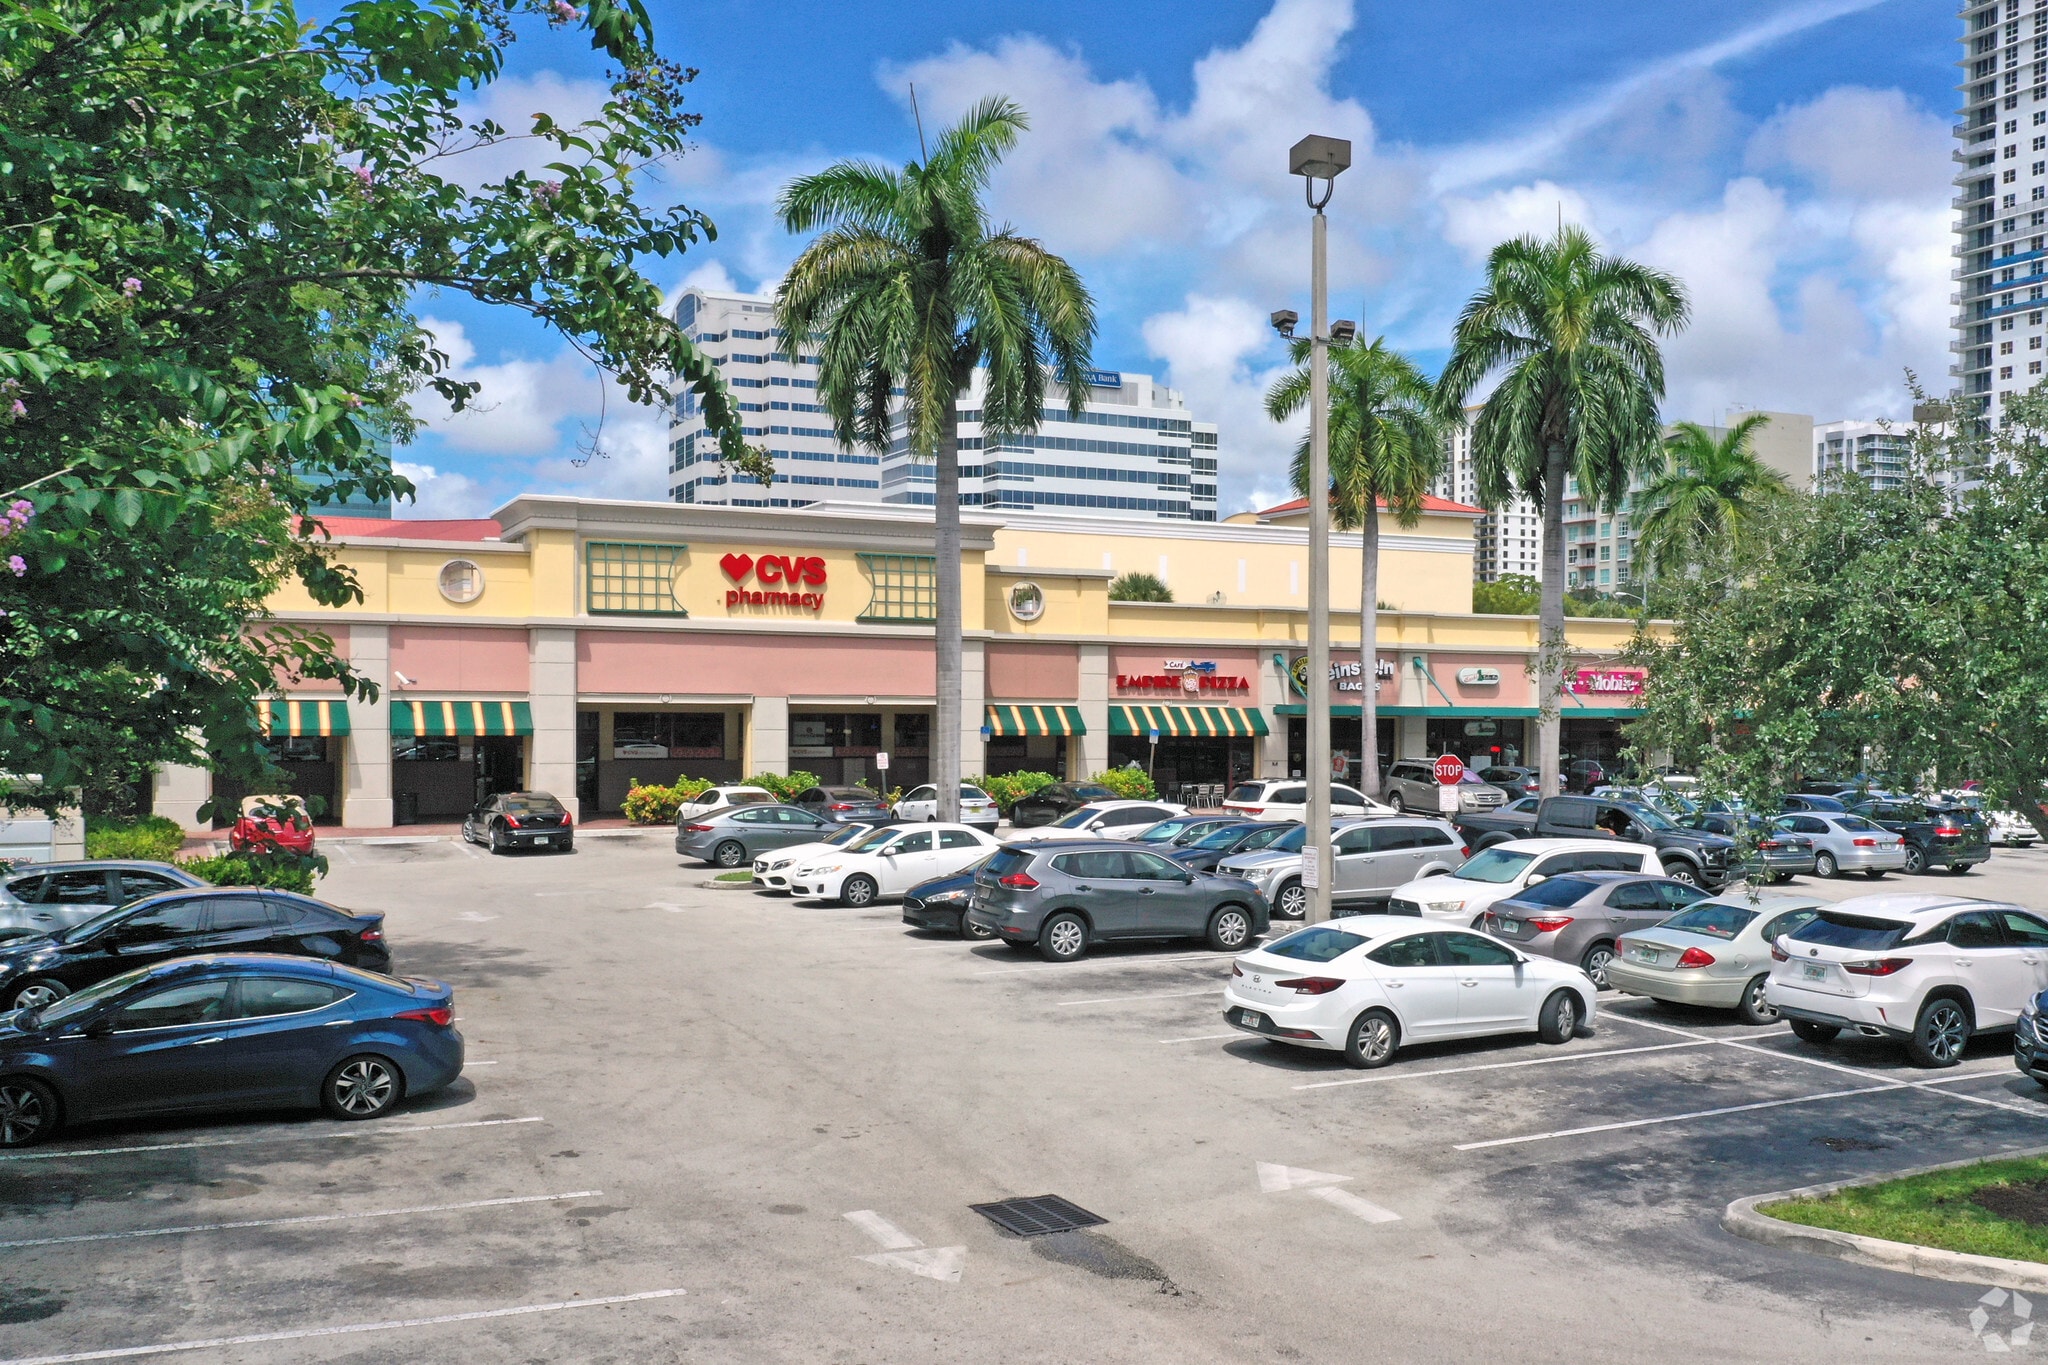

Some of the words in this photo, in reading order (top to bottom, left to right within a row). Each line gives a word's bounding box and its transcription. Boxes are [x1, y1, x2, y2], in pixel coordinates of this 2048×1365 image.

[1098, 374, 1117, 383] Bank
[755, 554, 827, 585] CVS
[726, 586, 824, 611] pharmacy
[1116, 675, 1182, 689] EMPIRE
[1198, 676, 1250, 689] PIZZA
[1338, 682, 1381, 691] BAGS
[1436, 764, 1462, 777] STOP
